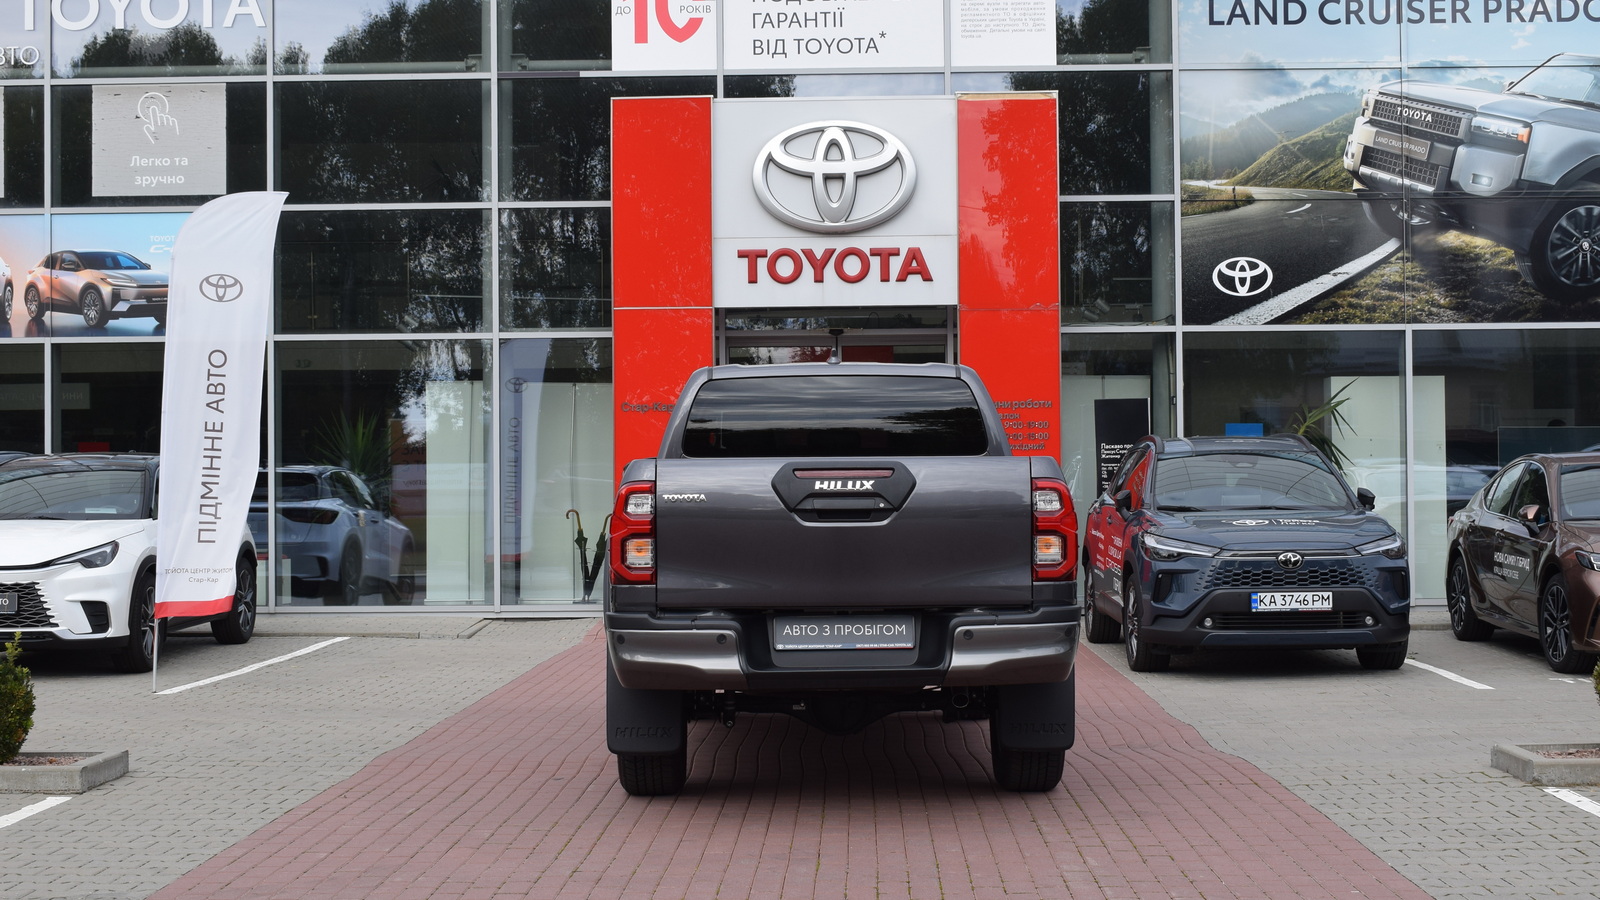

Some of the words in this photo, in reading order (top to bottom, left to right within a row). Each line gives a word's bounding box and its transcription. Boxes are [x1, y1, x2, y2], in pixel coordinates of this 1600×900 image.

[615, 6, 631, 15] ДО
[679, 5, 712, 13] РОКІВ
[1207, 0, 1308, 26] LAND
[1317, 0, 1472, 25] CRUISER
[752, 7, 844, 29] ГАРАНТІЇ
[752, 38, 787, 58] ВІД
[1397, 107, 1432, 123] TOYOTA
[130, 156, 171, 167] Легко
[174, 157, 189, 166] та
[134, 175, 185, 187] зручно
[737, 247, 933, 285] TOYOTA
[206, 349, 228, 414] АВТО
[1012, 398, 1052, 410] роботи
[197, 420, 224, 544] ПІДМІННЕ
[814, 480, 875, 490] HILUX
[662, 494, 707, 502] TOYOTA
[165, 567, 190, 575] ТОЙОТА
[190, 567, 210, 575] ЦЕНТР
[1105, 557, 1122, 576] CROSS
[188, 577, 220, 585] Стар-Кар
[1258, 594, 1278, 607] KA
[1280, 594, 1310, 607] 3746
[1312, 594, 1331, 606] PM
[782, 624, 819, 636] АВТО
[822, 624, 831, 636] З
[834, 624, 907, 636] ПРОБІГОМ
[614, 726, 673, 738] HILUX
